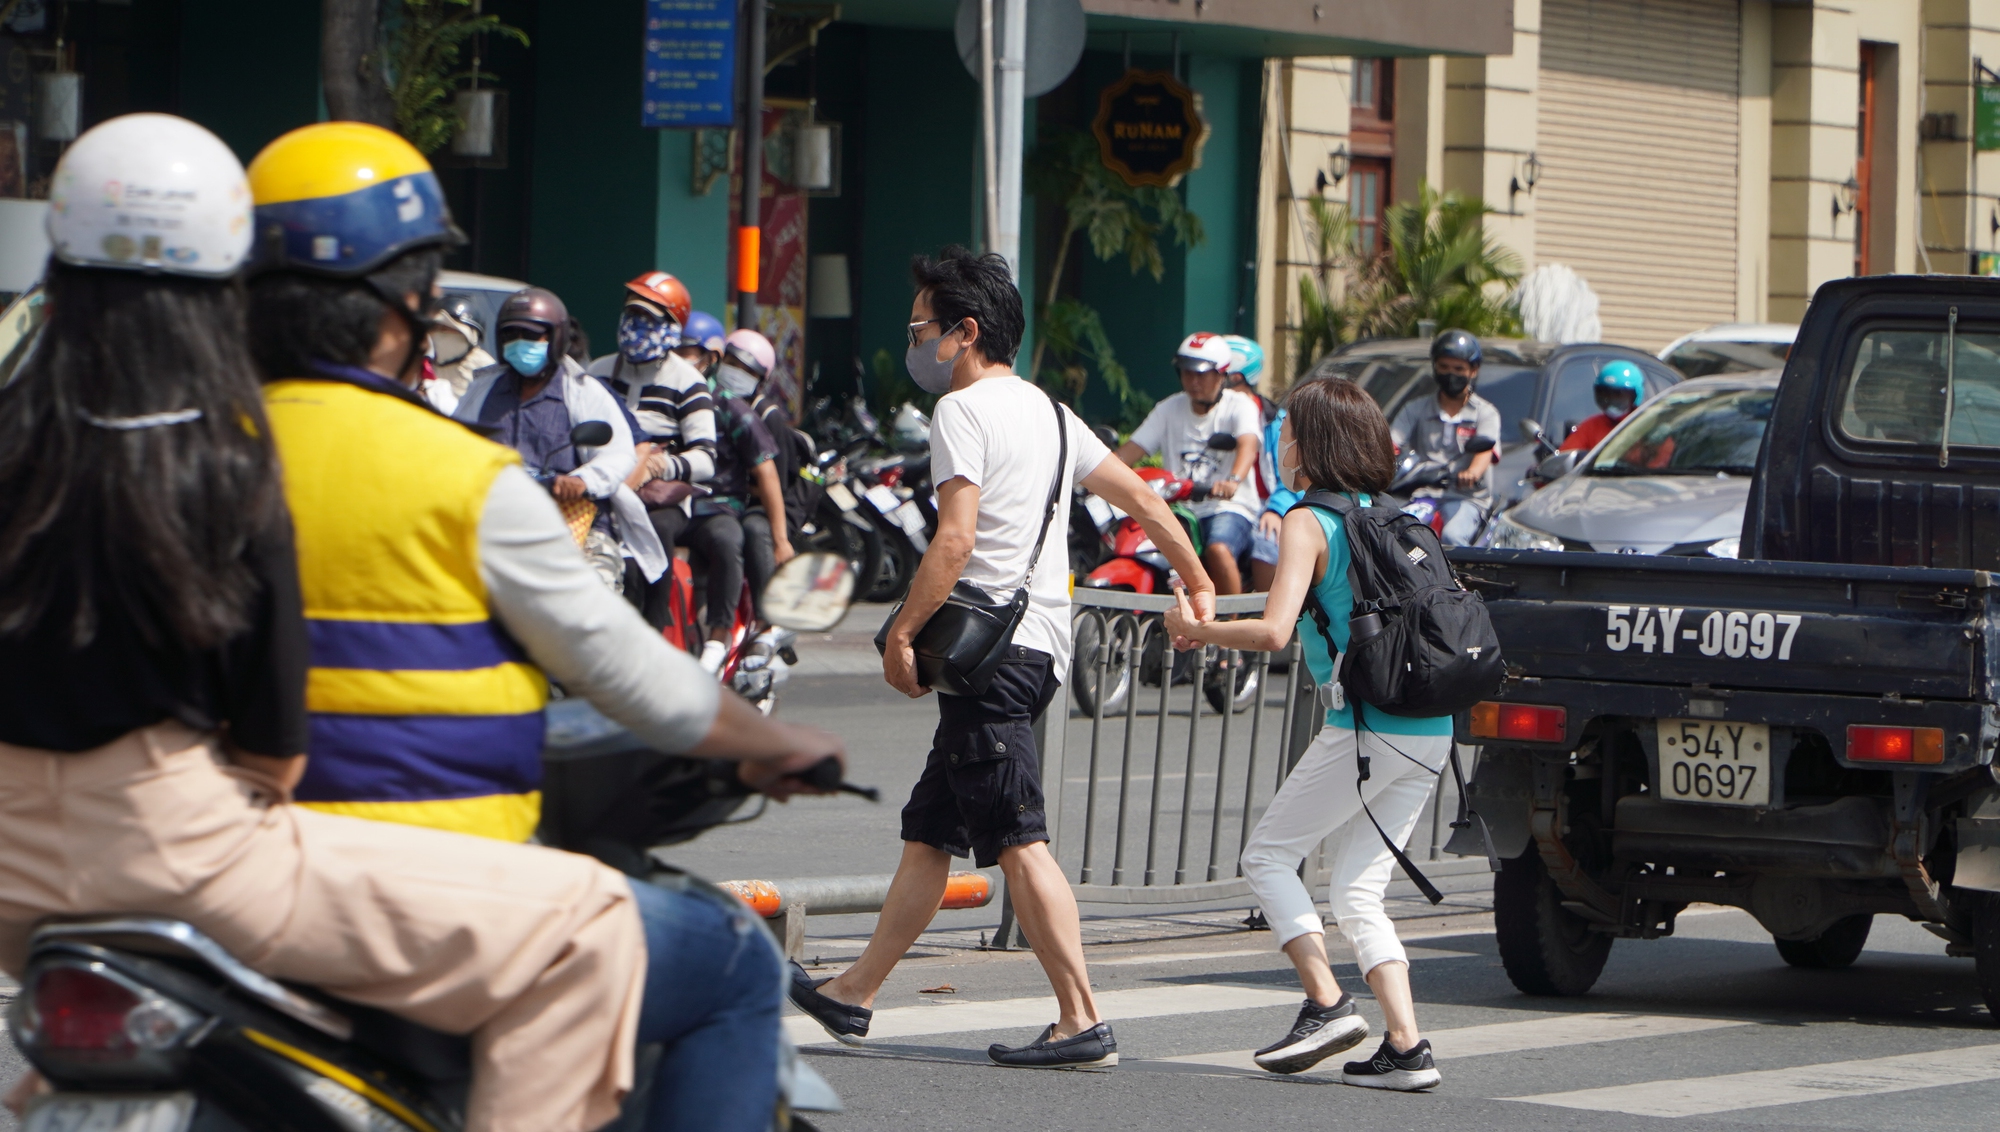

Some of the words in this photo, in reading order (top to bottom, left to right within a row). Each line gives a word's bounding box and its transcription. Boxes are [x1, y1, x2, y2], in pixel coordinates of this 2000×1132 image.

[1606, 605, 1802, 661] 54Y-0697
[1681, 723, 1744, 760] 54Y
[1672, 761, 1757, 800] 0697
